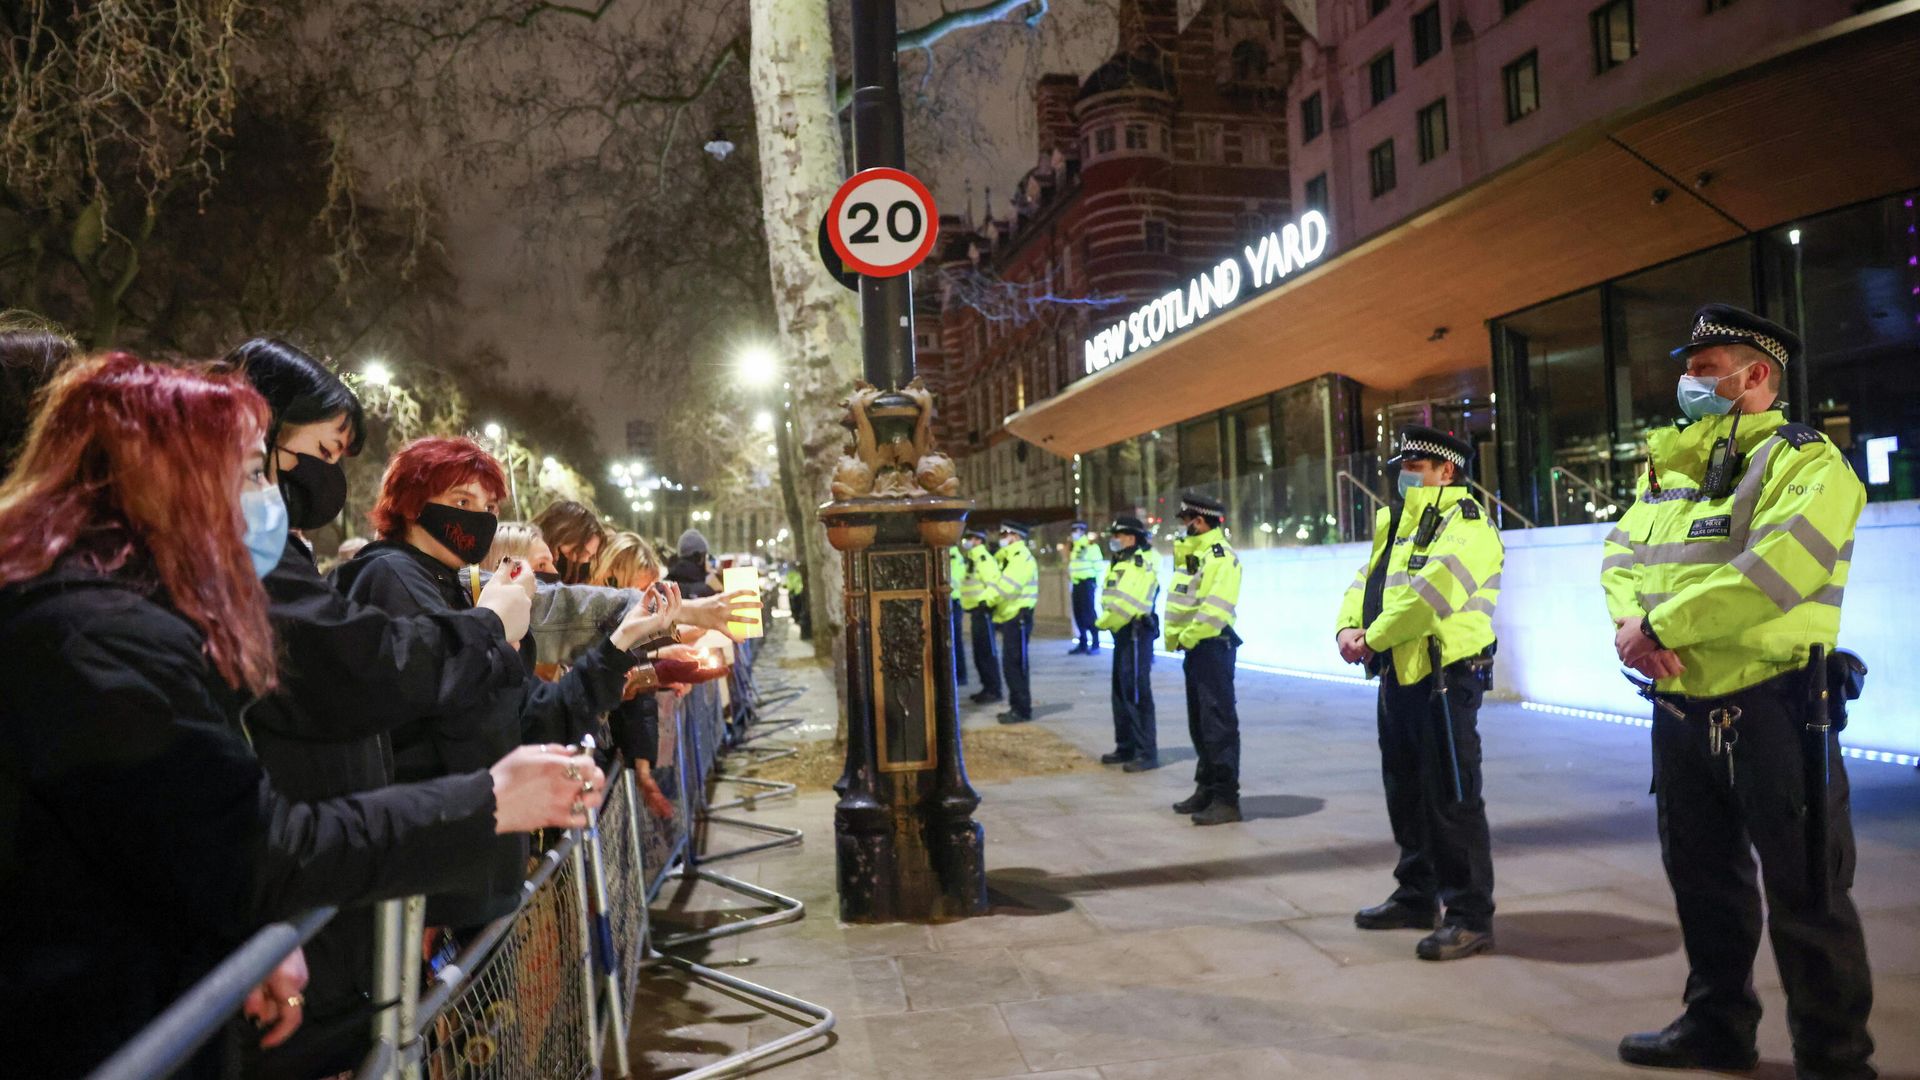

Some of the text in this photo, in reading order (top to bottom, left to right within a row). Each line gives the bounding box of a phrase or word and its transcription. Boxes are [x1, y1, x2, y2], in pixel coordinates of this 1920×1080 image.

[847, 200, 922, 244] 20
[1085, 210, 1328, 374] NEW SCOTLAND YARD
[1788, 483, 1825, 496] POLCE
